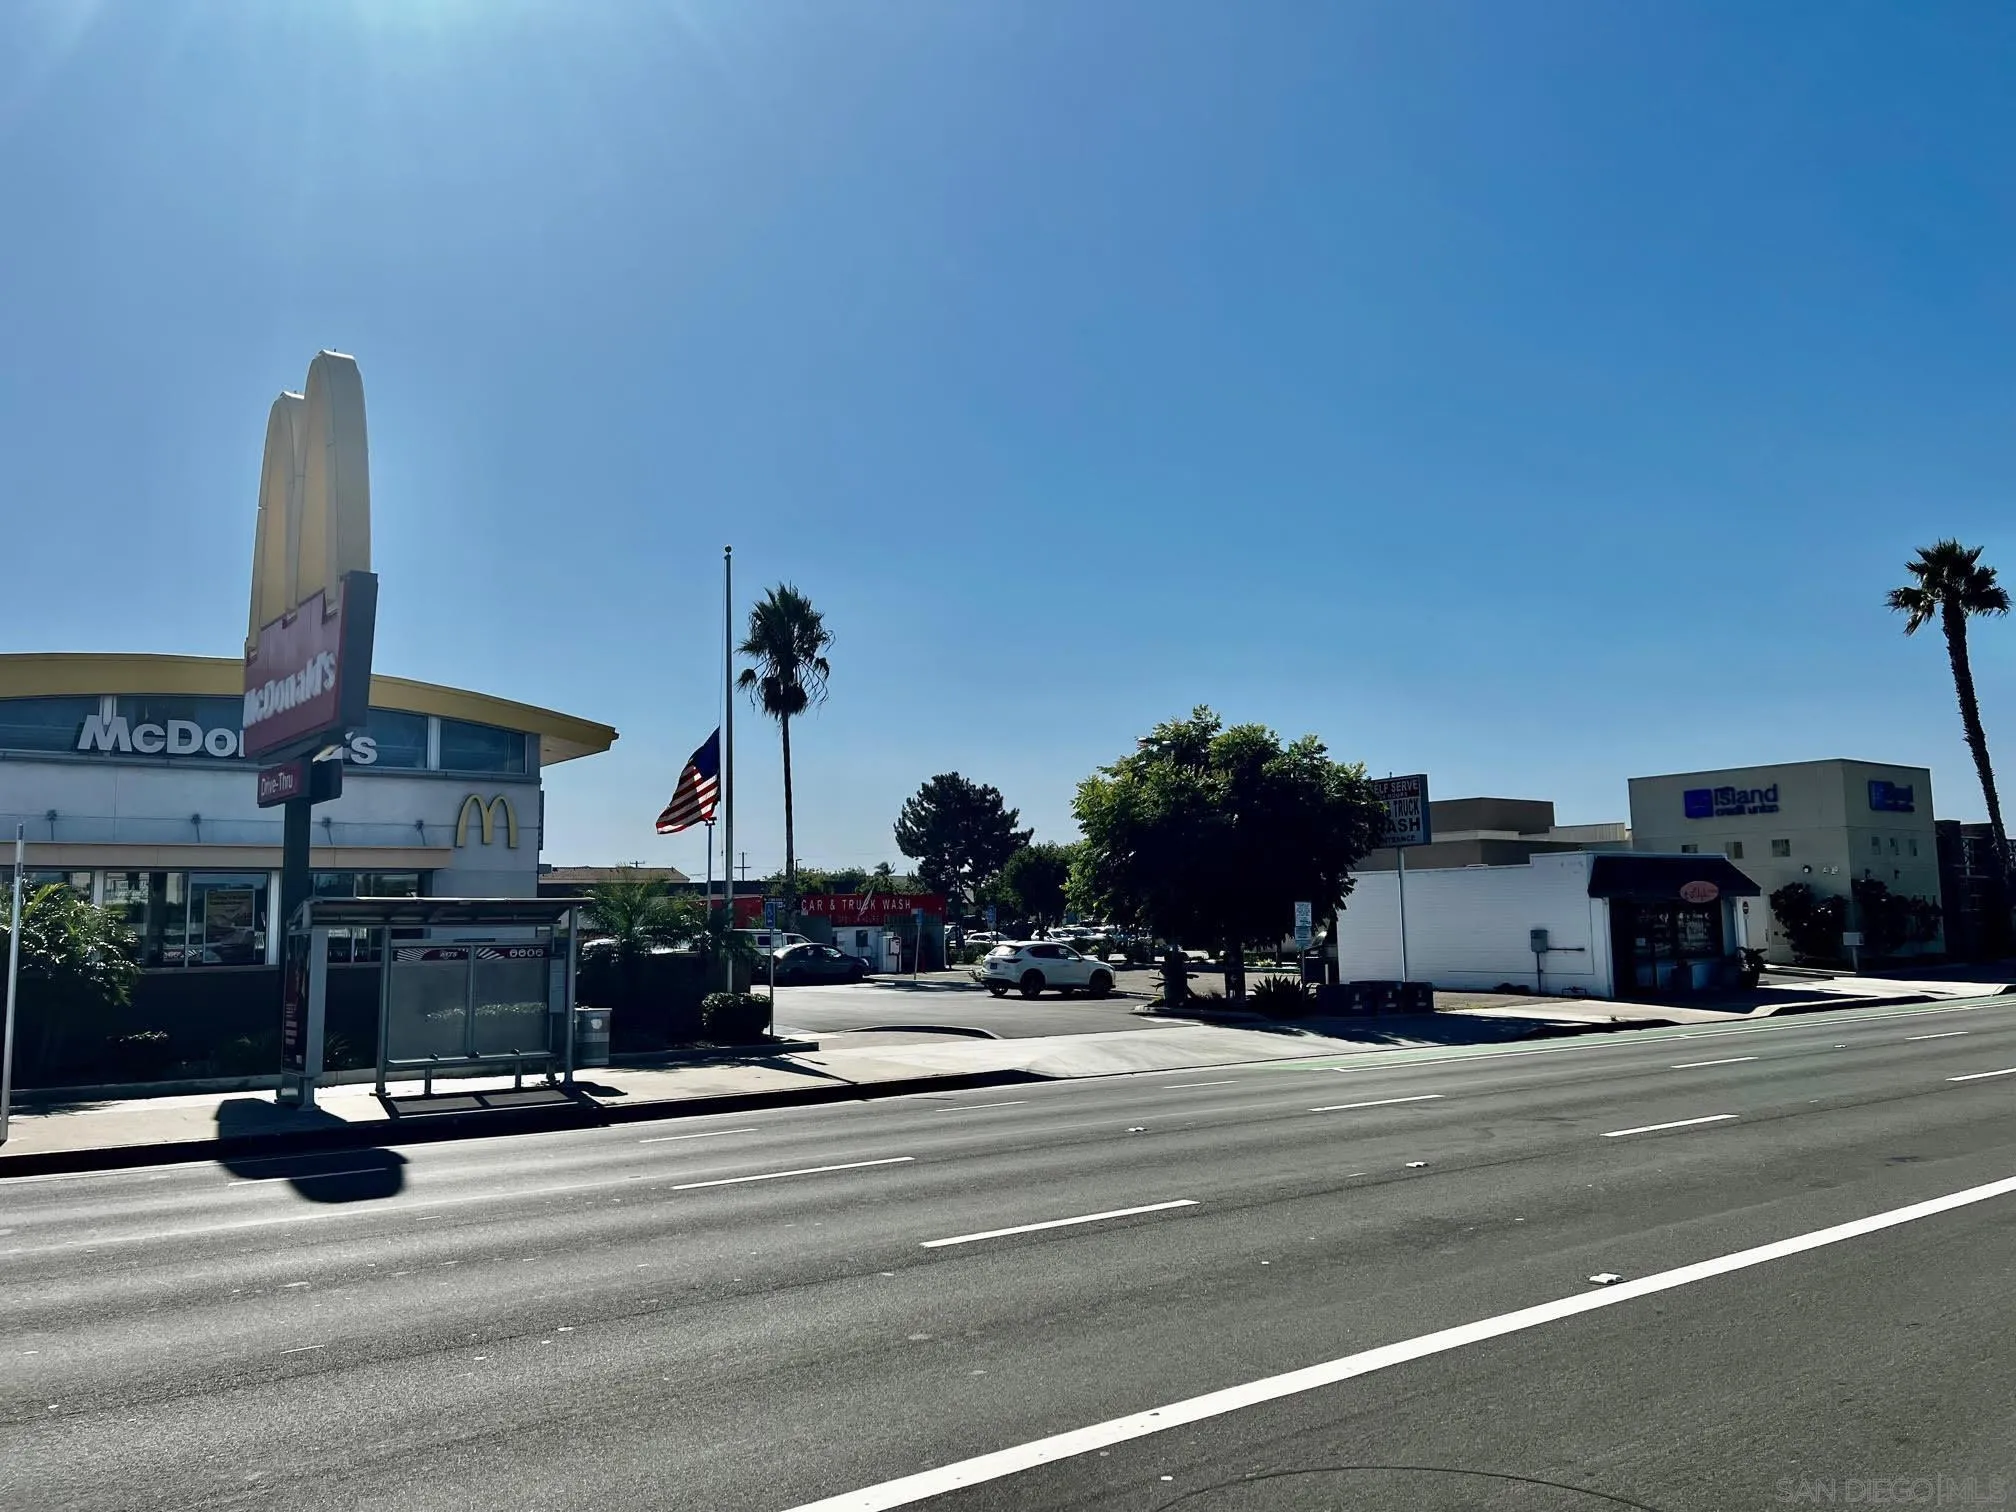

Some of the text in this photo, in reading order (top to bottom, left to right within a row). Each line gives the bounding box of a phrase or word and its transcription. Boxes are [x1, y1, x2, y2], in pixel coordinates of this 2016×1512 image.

[243, 650, 337, 728] McDonald's
[77, 714, 378, 765] McDo's
[261, 772, 294, 797] Drive-Thru
[1391, 779, 1419, 792] SERVE
[1393, 798, 1419, 817] TRUCK
[801, 899, 823, 911] CAR
[829, 899, 836, 911] &
[883, 899, 911, 910] WASH
